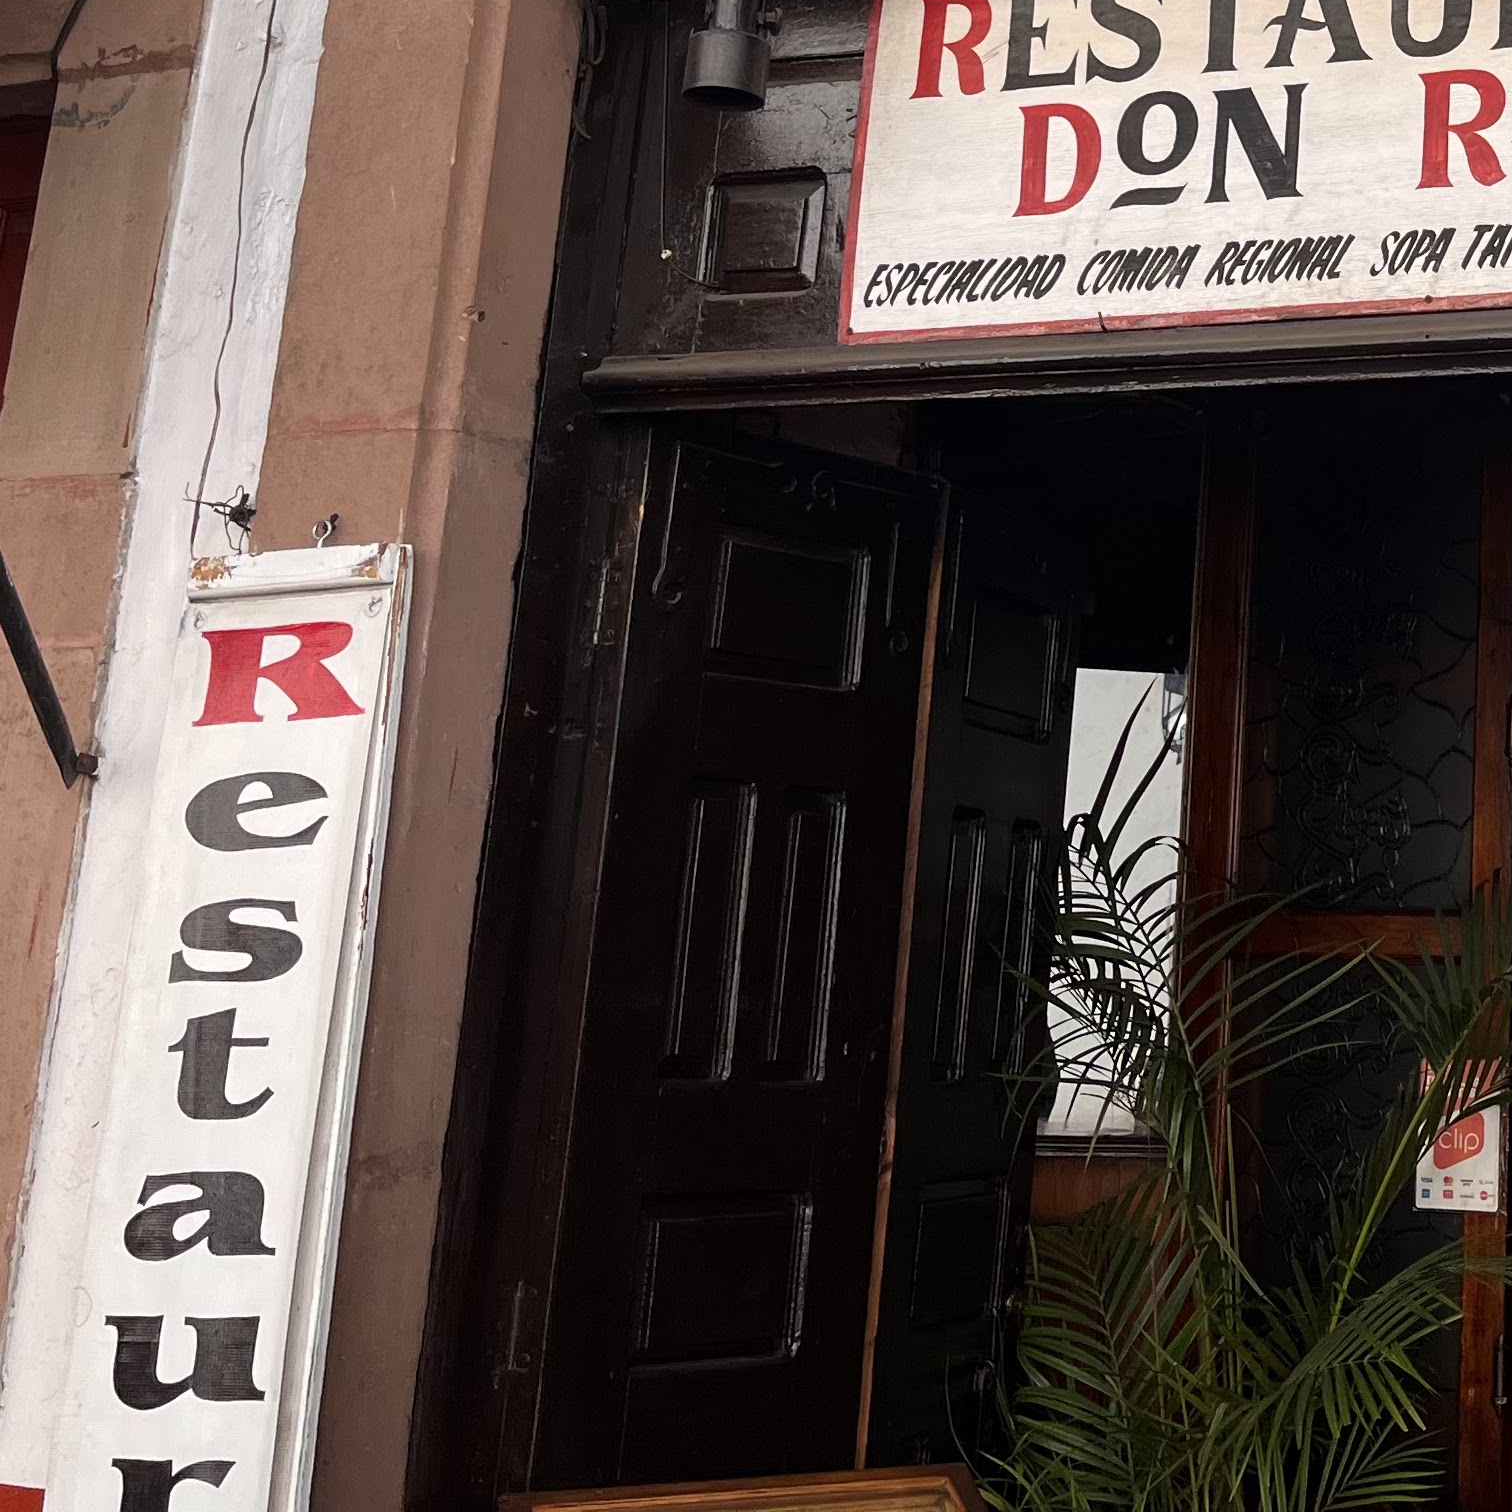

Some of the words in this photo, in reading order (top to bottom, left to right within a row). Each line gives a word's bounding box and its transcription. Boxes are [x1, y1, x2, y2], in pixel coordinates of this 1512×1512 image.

[1012, 83, 1308, 217] DON
[863, 253, 1067, 308] ESPECIALIDAD
[1077, 244, 1201, 296] COMIDA
[1204, 233, 1355, 287] REGIONAL
[1370, 226, 1455, 276] SOPA
[1439, 1128, 1480, 1154] clip
